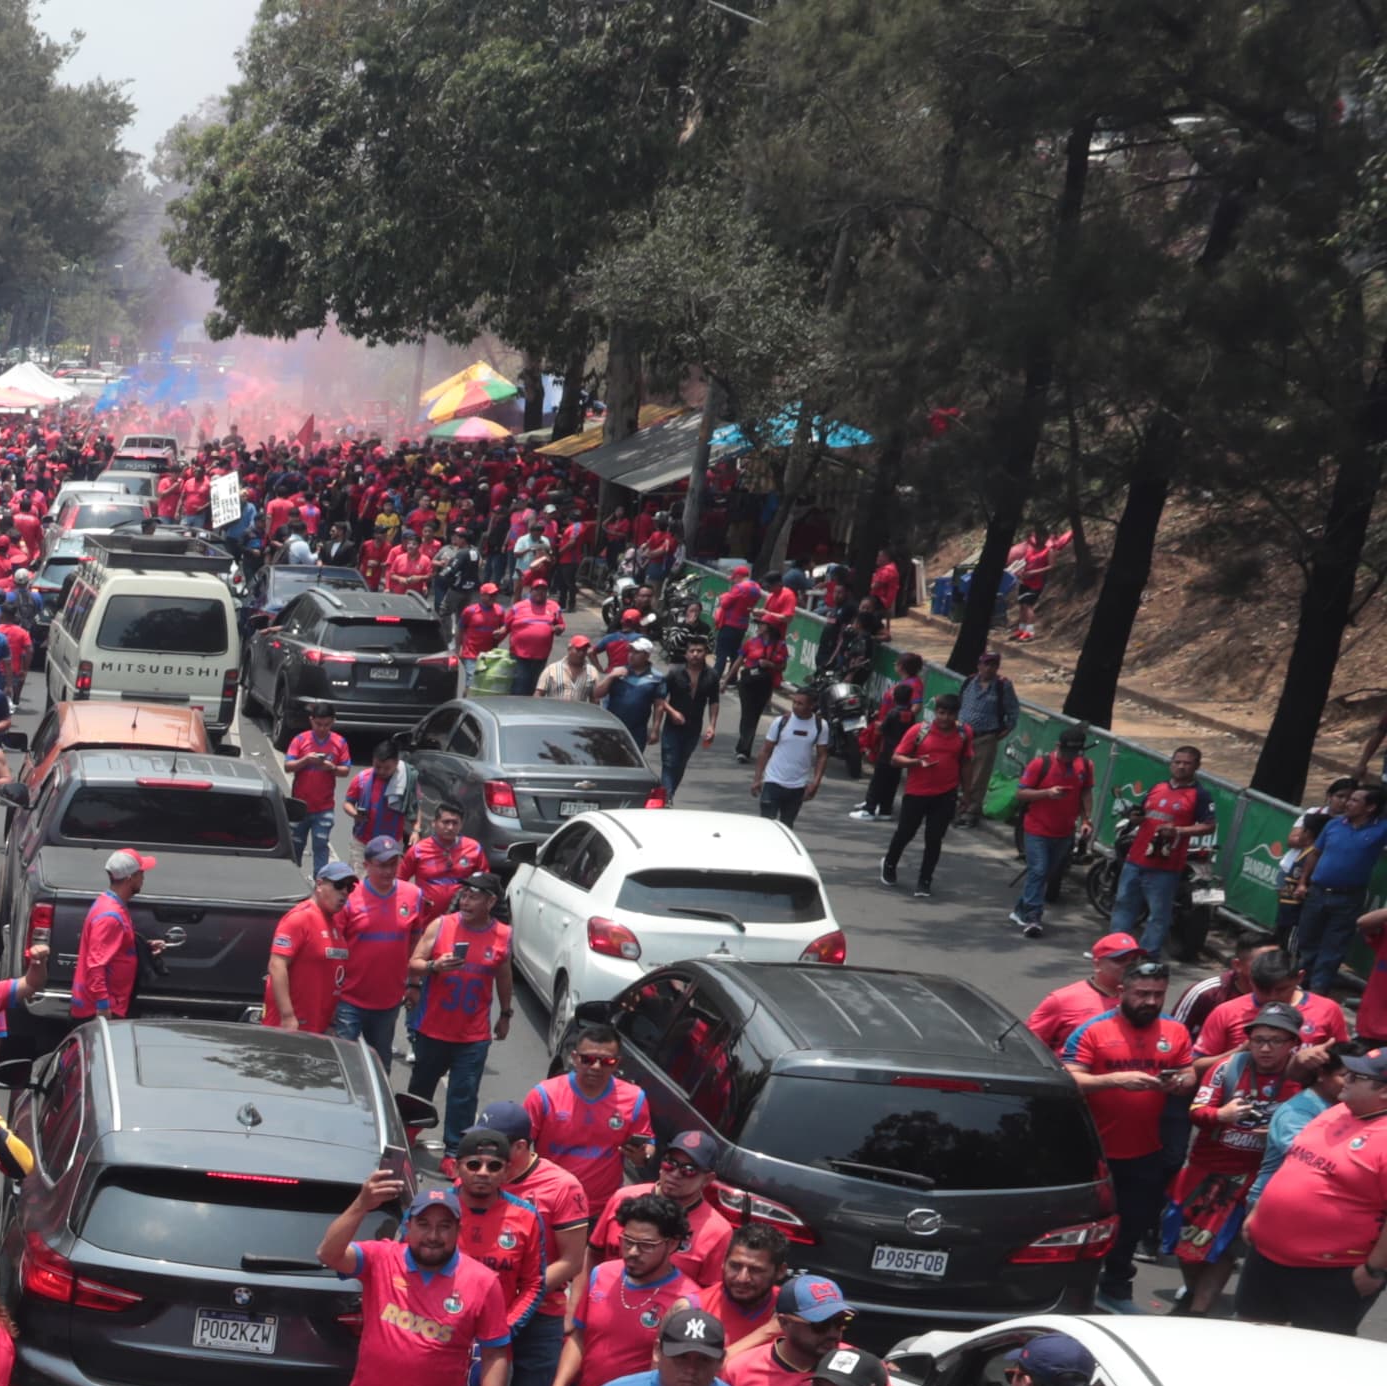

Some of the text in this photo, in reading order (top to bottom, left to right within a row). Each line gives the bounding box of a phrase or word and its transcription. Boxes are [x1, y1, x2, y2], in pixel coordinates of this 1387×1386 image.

[101, 662, 219, 678] MITSUBISHI
[442, 974, 482, 1013] 36
[876, 1249, 945, 1276] P985FQB
[199, 1318, 272, 1346] P002KZW
[380, 1303, 455, 1343] ROJOS
[684, 1318, 707, 1339] NY
